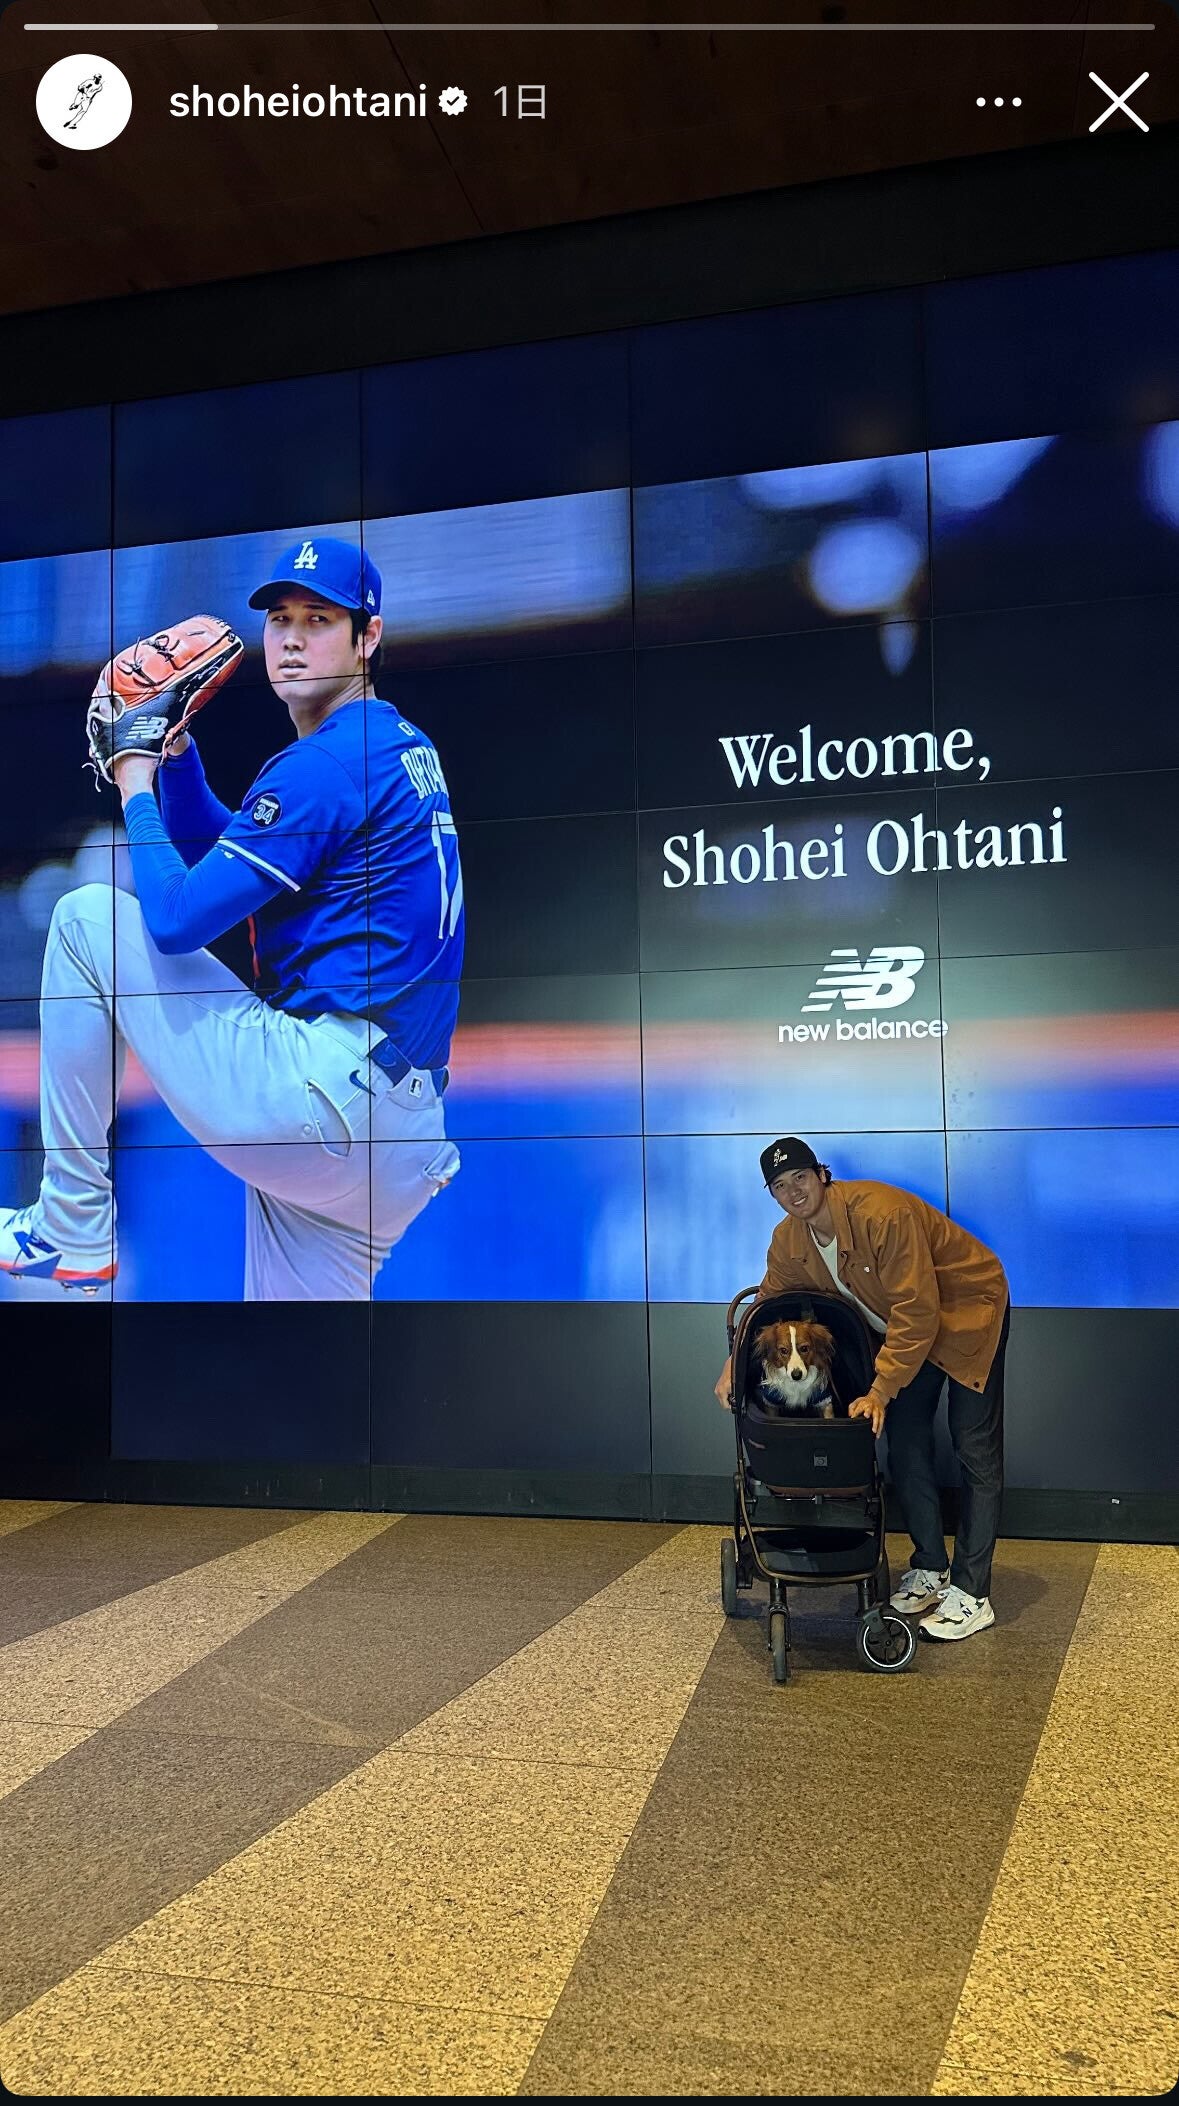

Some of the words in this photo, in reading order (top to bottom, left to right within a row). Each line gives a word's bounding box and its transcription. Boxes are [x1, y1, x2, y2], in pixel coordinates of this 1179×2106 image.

[293, 540, 319, 570] LA
[719, 724, 991, 788] Welcome,
[253, 804, 275, 825] 34
[662, 823, 848, 888] Shohei
[866, 806, 1068, 876] Ohtani
[800, 945, 925, 1013] NB
[778, 1023, 831, 1043] new
[836, 1017, 949, 1041] balance
